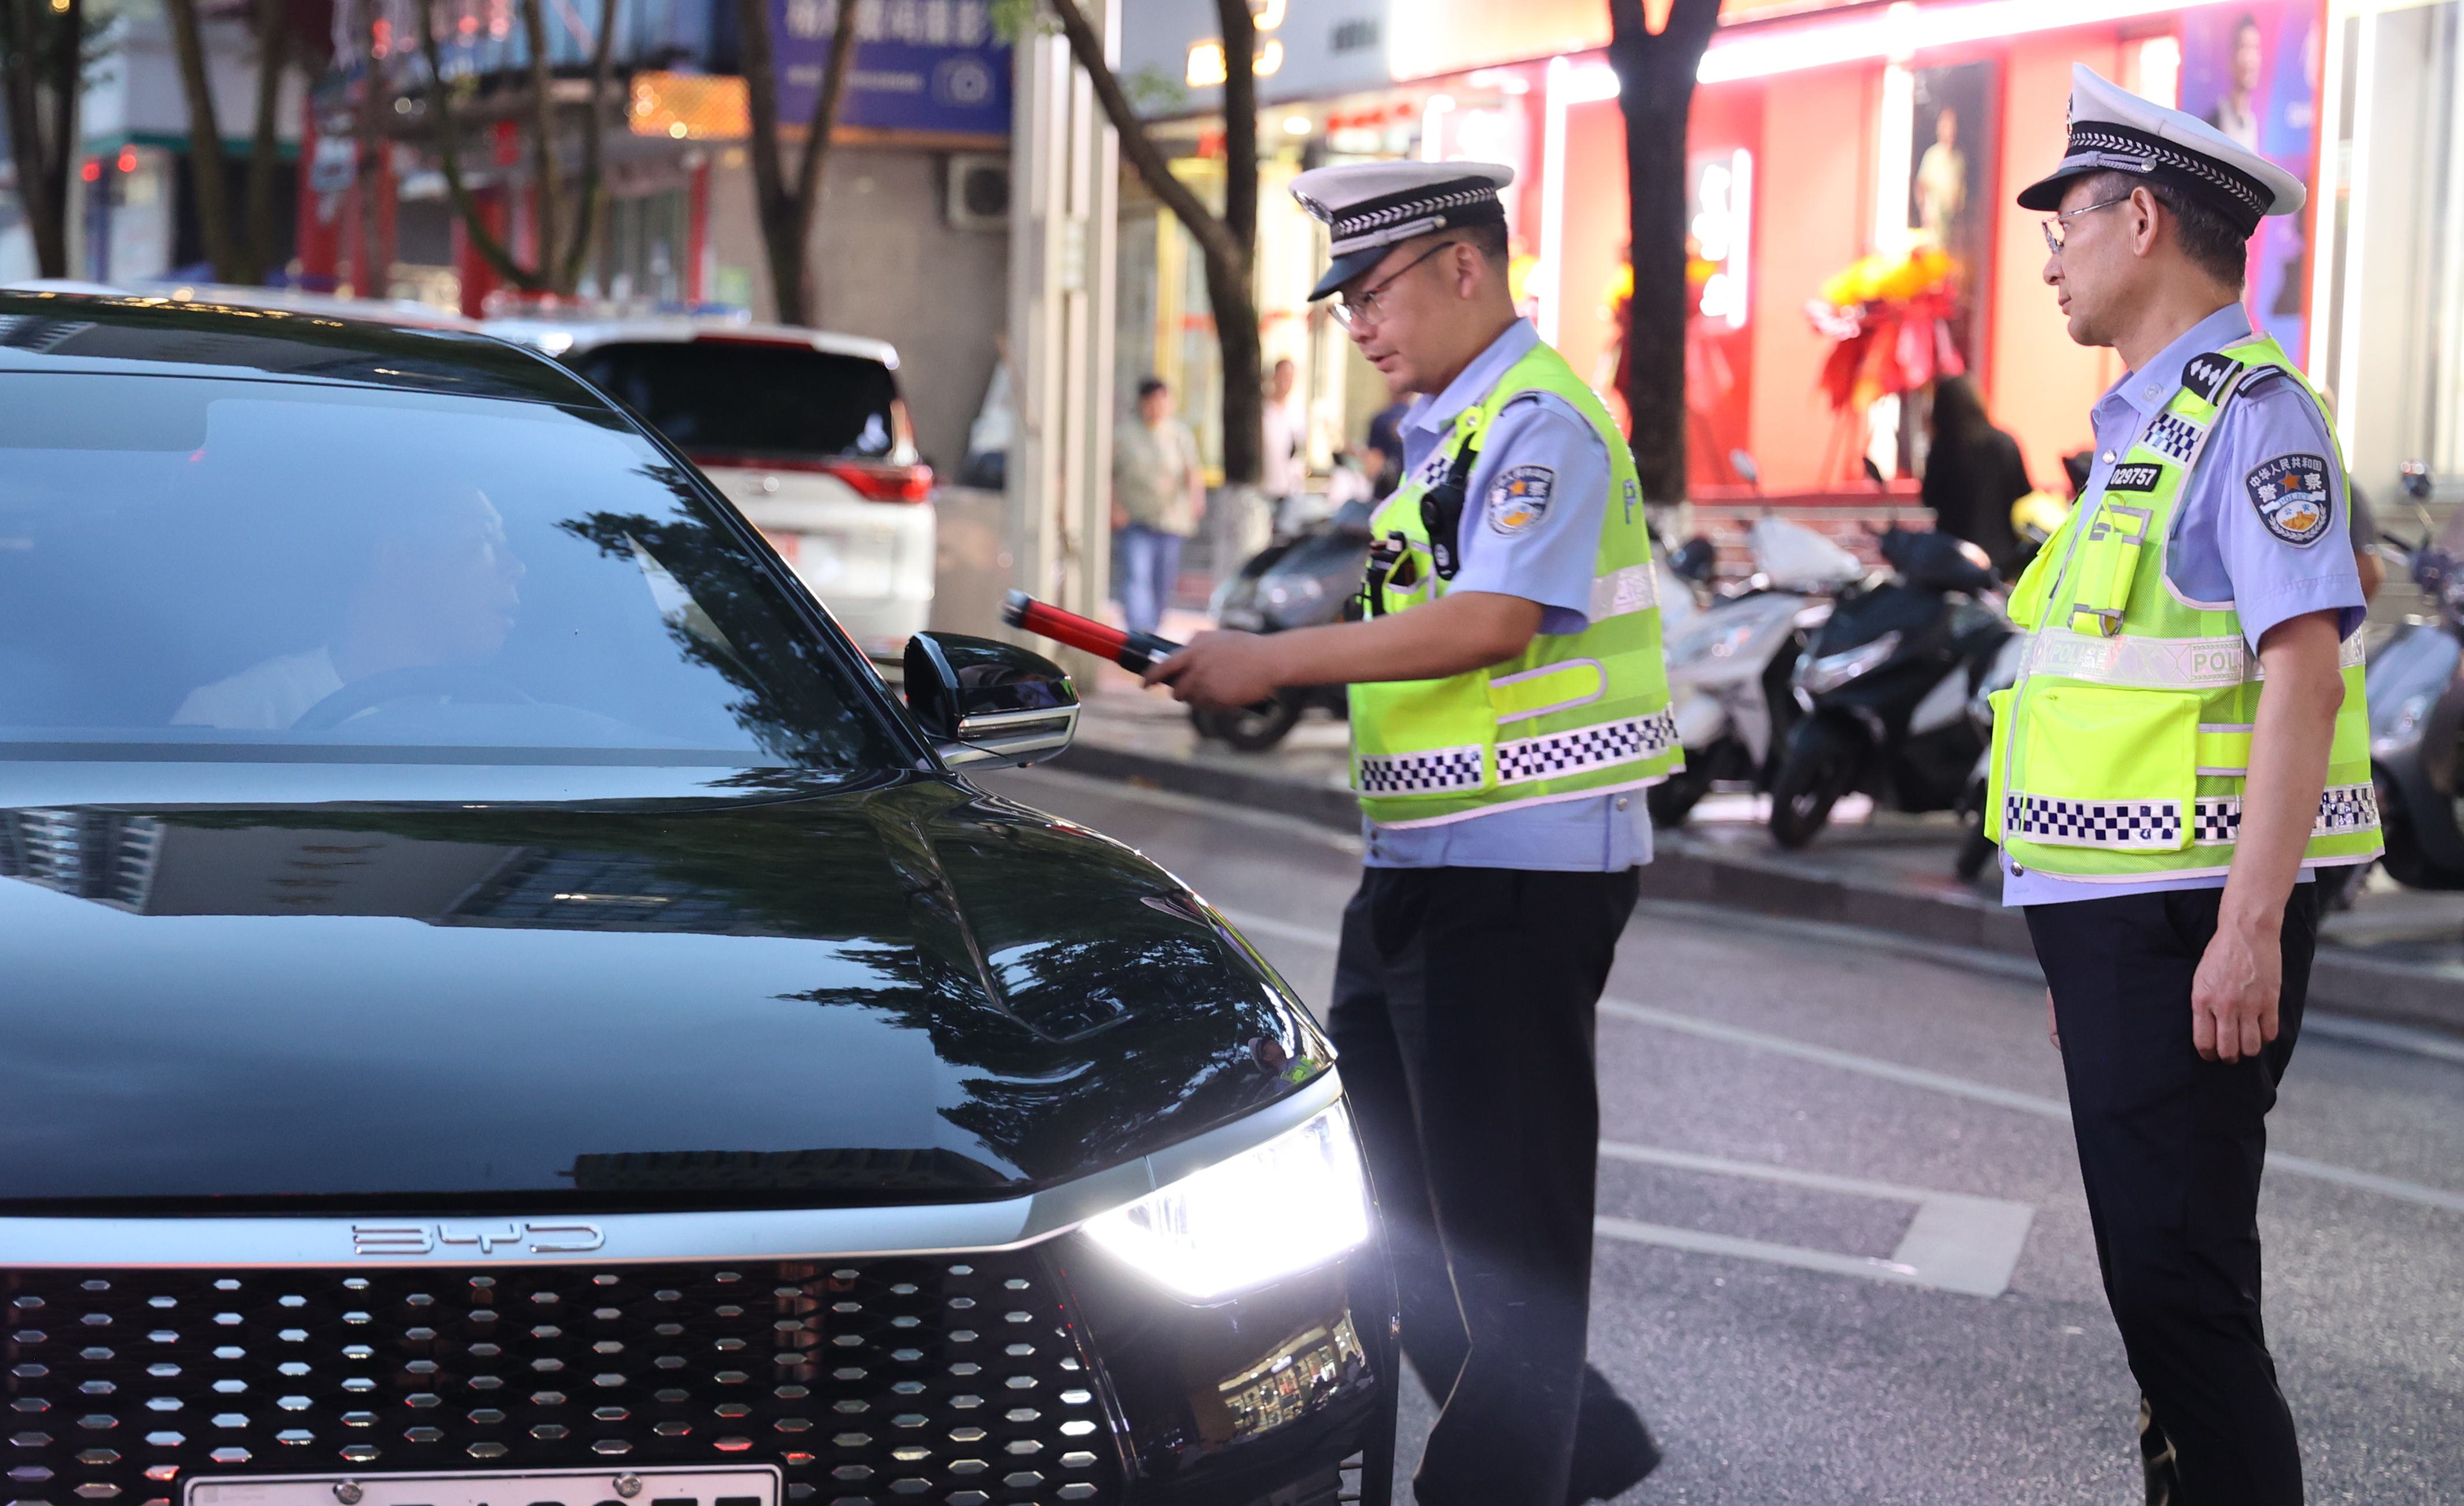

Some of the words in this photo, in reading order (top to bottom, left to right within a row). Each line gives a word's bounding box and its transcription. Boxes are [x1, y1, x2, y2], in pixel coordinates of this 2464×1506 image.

[2110, 468, 2157, 485] 029757
[2249, 457, 2321, 487] 中华人民共和国
[2258, 473, 2322, 503] 警察
[2279, 492, 2311, 505] POLICE
[2194, 652, 2238, 673] POL
[352, 1222, 605, 1255] BYD
